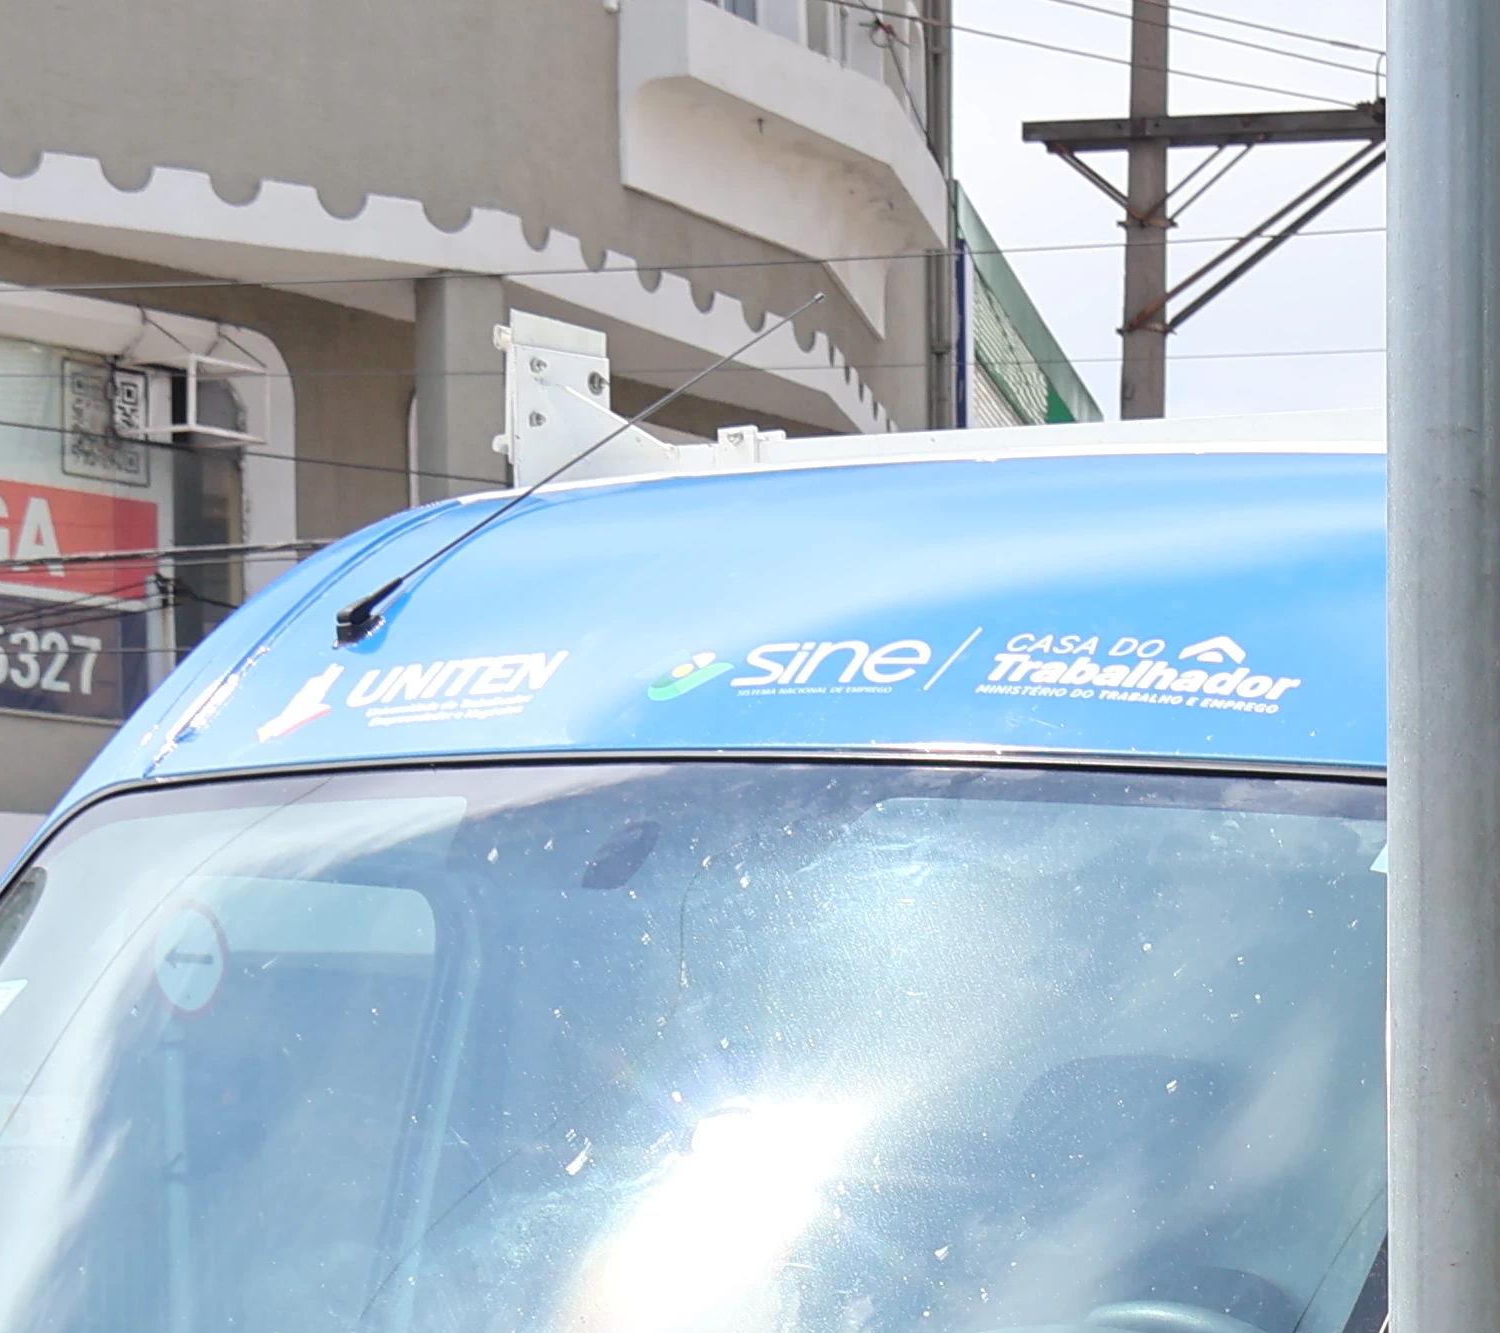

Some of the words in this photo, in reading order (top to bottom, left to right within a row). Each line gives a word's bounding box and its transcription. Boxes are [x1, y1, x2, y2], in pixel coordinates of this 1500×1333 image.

[730, 639, 932, 686] sine
[1006, 632, 1099, 655] CASA
[1108, 637, 1165, 658] DO
[347, 651, 569, 707] UNITEN
[778, 687, 826, 696] NACIONAL
[830, 687, 843, 695] DE
[846, 686, 893, 695] EMPREGO
[987, 653, 1301, 700] Trabalhador
[975, 684, 1067, 698] MINISTÉRIO
[1070, 688, 1094, 699] DO
[1098, 690, 1180, 705] TRABALHO
[1186, 696, 1199, 706] E
[1200, 697, 1279, 714] EMPREGO
